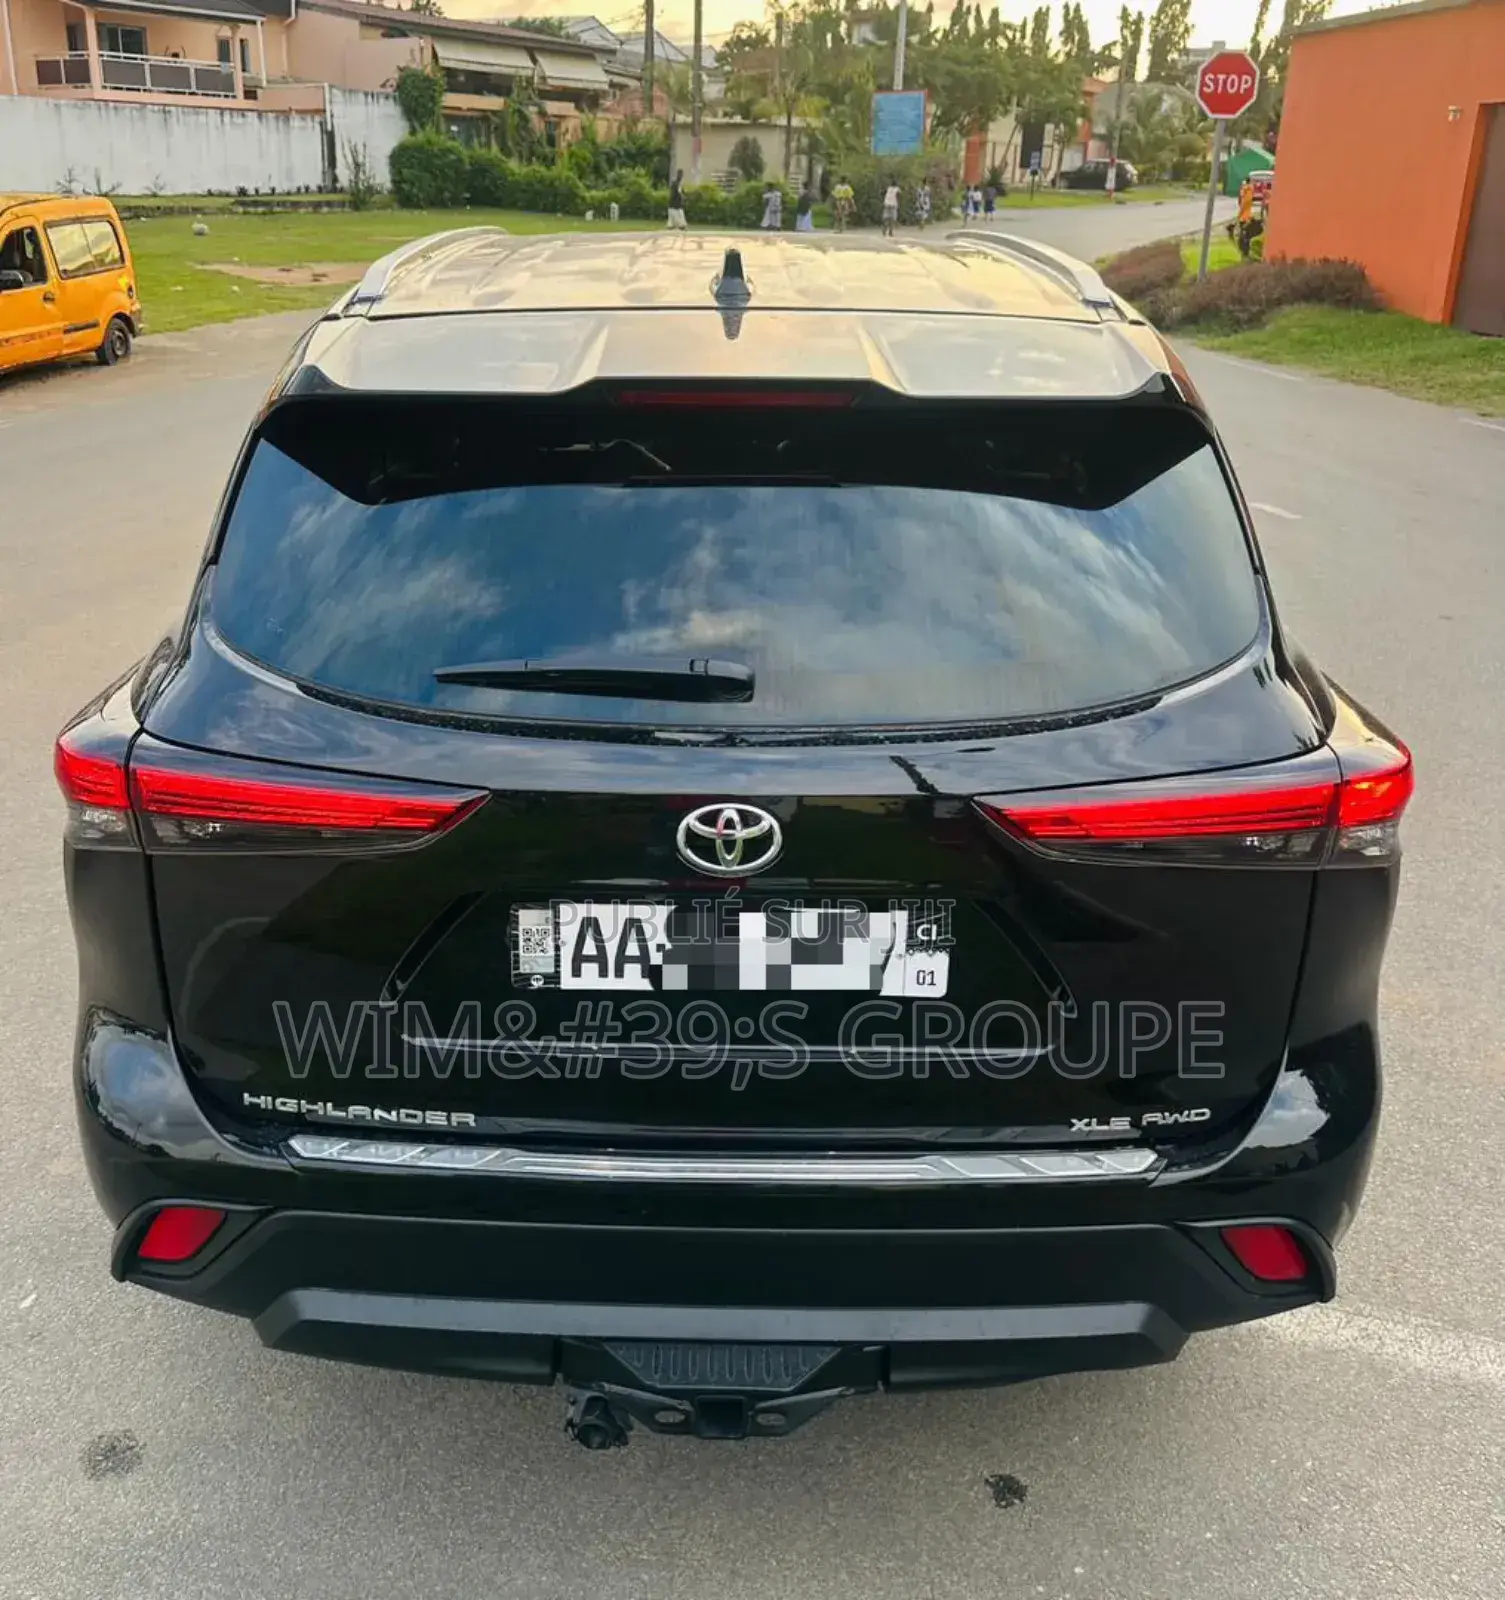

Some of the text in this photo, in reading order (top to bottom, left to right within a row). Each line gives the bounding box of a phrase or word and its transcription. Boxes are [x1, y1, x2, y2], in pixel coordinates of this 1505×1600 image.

[1203, 73, 1252, 95] STOP
[916, 923, 937, 941] CI
[916, 969, 937, 986] 01
[243, 1092, 477, 1127] HIGHLANDER
[1070, 1108, 1212, 1132] XLE AWD
